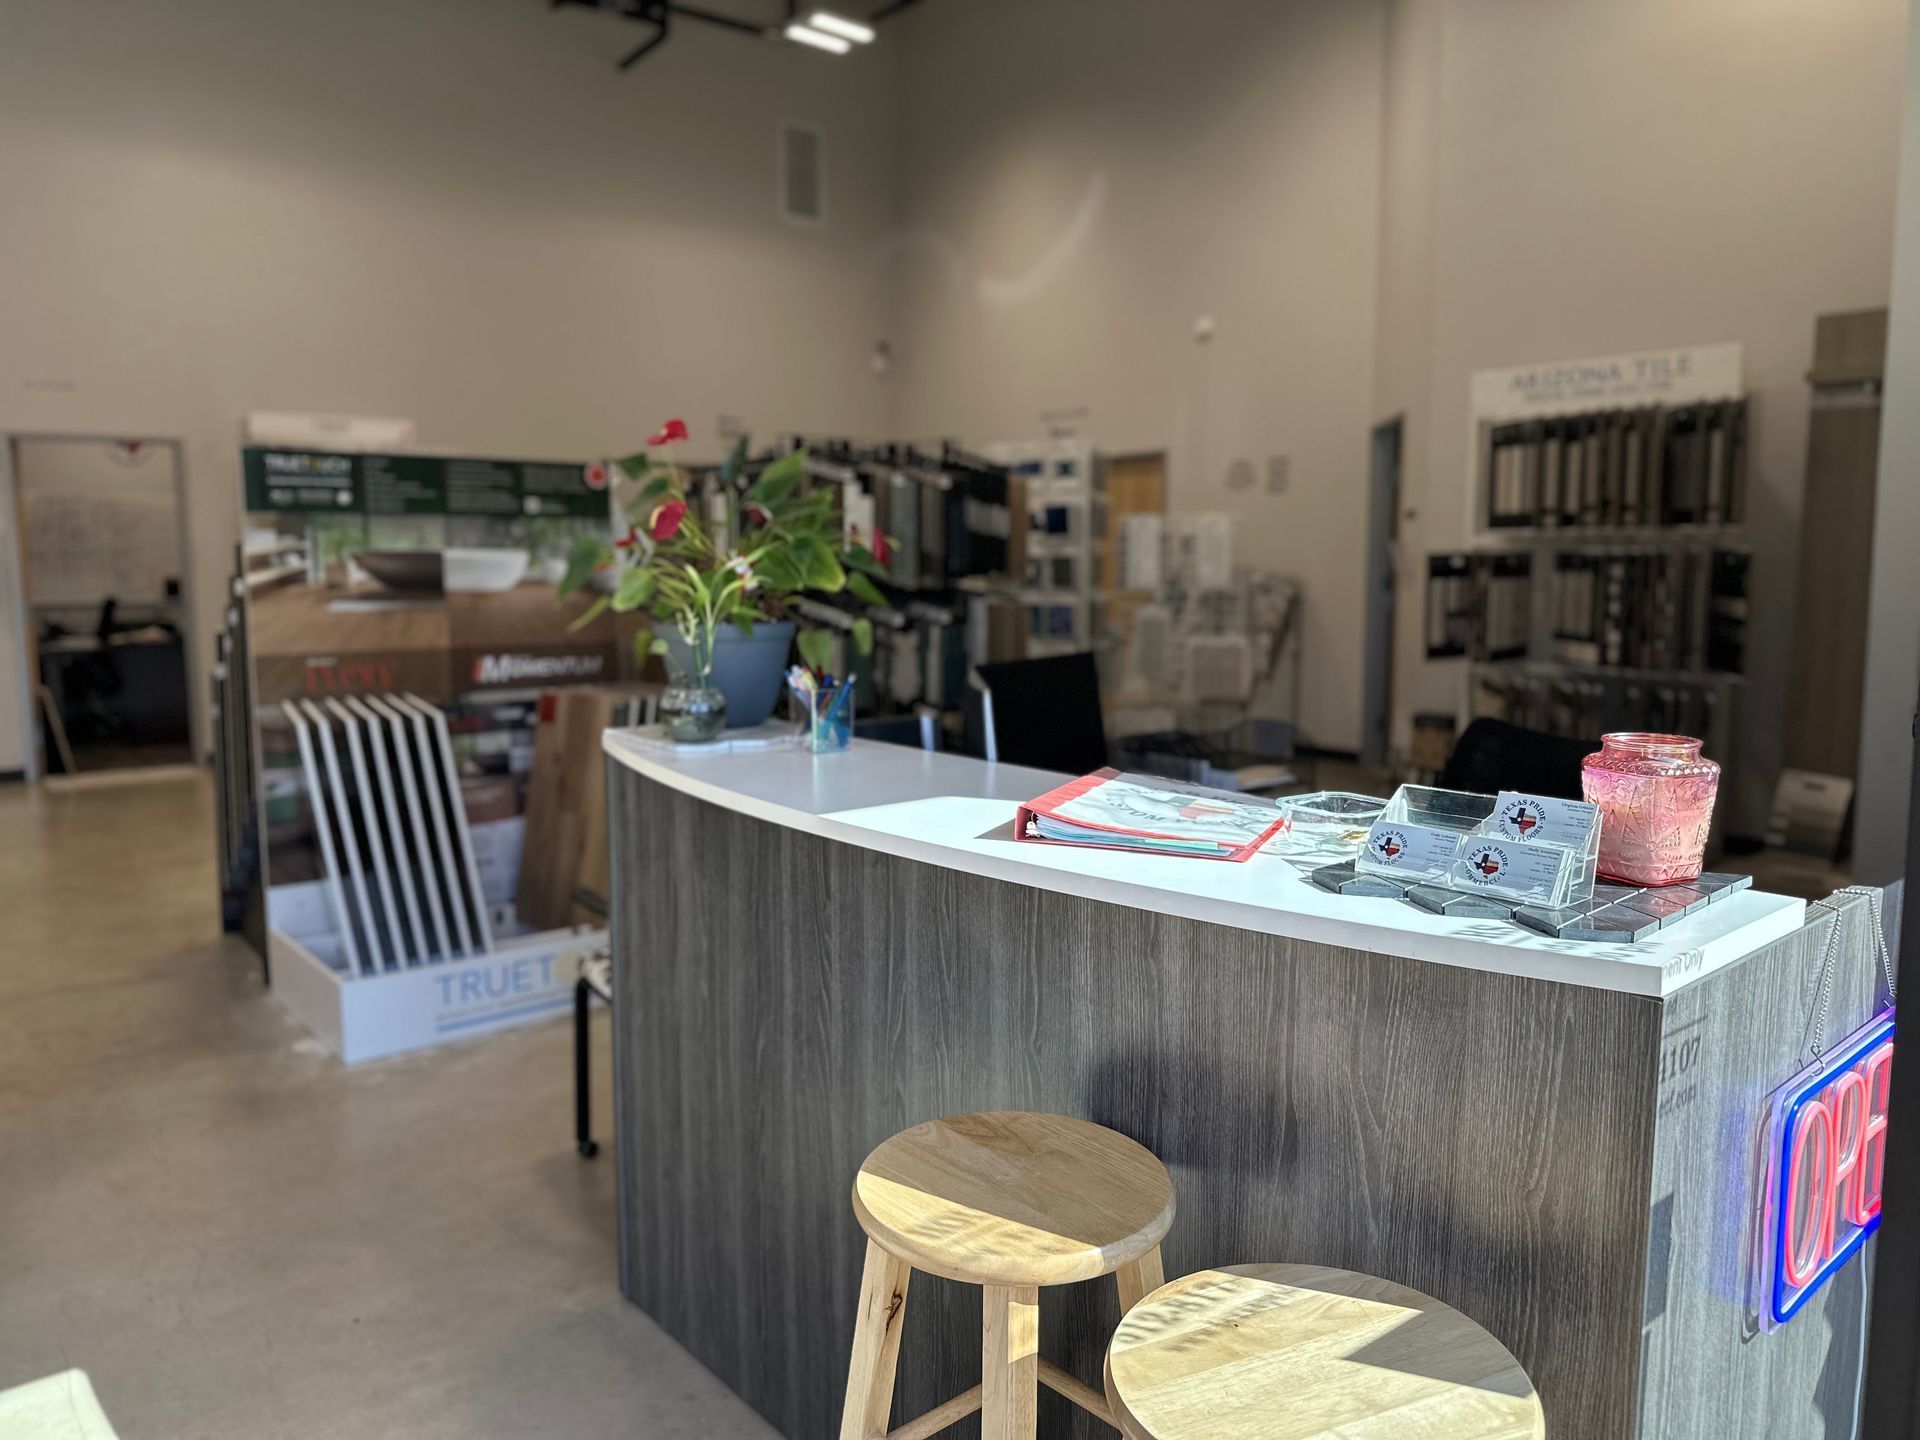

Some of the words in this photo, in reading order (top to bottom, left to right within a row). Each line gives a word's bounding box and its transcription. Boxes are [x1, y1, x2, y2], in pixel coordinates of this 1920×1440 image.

[1635, 351, 1694, 379] TILE
[1501, 799, 1528, 816] TEXAS
[1529, 800, 1546, 821] PRIDE
[1373, 830, 1394, 844] TEXAS
[1394, 831, 1408, 849] PRIDE
[1517, 825, 1544, 843] FLOORS
[1468, 845, 1492, 862] TEXAS
[1493, 846, 1508, 868] PRIDE
